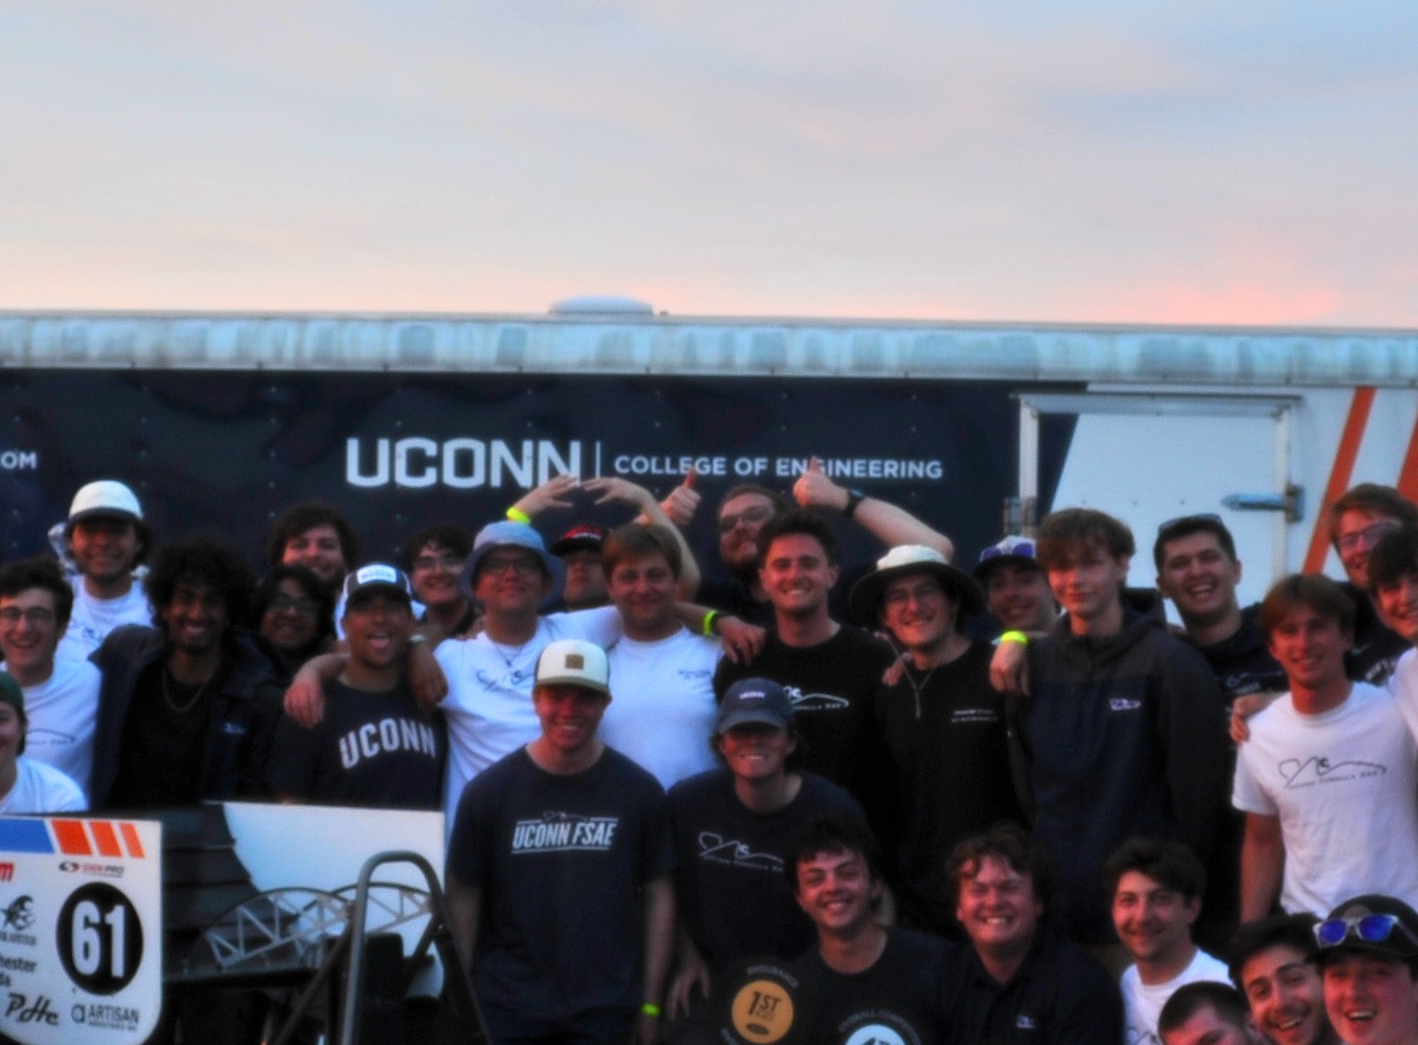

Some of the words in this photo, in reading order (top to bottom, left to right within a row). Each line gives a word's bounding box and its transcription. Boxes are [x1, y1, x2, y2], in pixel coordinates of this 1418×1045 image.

[346, 437, 580, 488] UCONN
[615, 455, 726, 476] COLLEGE
[734, 457, 768, 476] OF
[339, 719, 436, 769] UCONN
[512, 823, 569, 849] UCONN
[570, 821, 615, 848] FSAE
[72, 900, 127, 979] 61
[88, 1004, 139, 1024] ARTISAN
[749, 990, 781, 1016] 1ST
